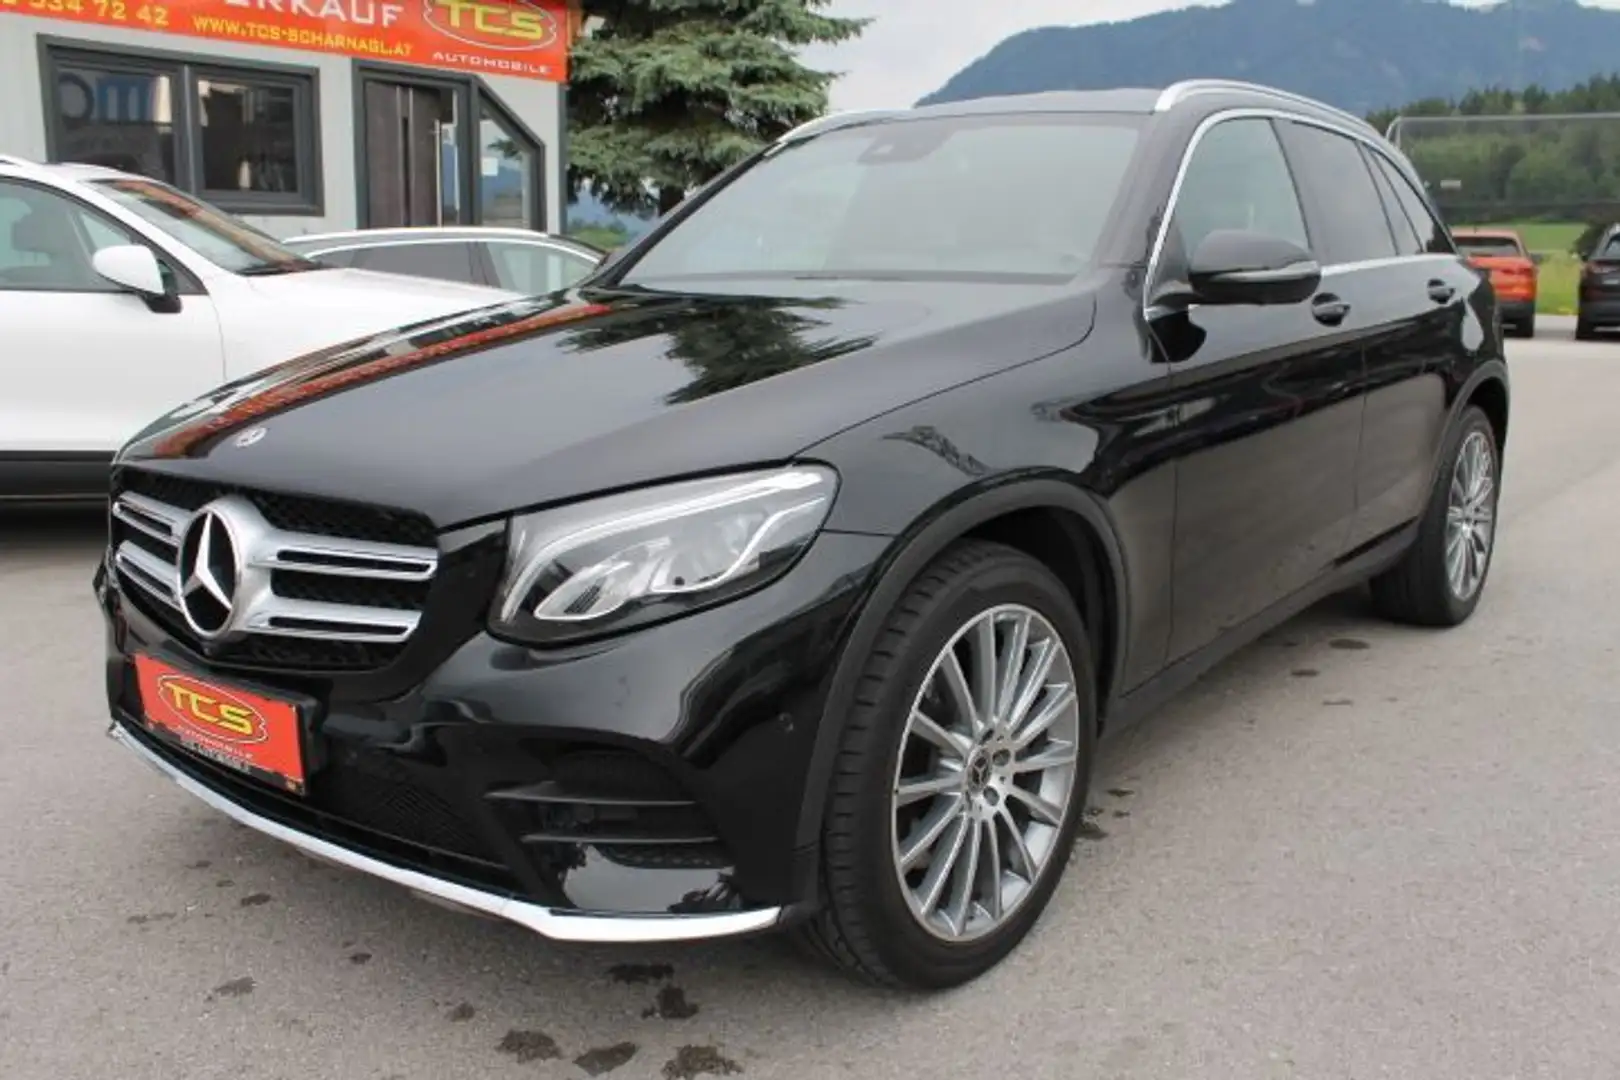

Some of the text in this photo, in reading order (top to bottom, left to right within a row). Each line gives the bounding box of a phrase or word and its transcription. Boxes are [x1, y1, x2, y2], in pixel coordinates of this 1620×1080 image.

[93, 0, 127, 20] 72
[135, 4, 170, 26] 42
[435, 0, 543, 39] TCS
[192, 15, 413, 56] WWW.TCS-SCHARNAGL.AT
[432, 51, 550, 74] AUTOMOBILE
[164, 681, 253, 735] TCS
